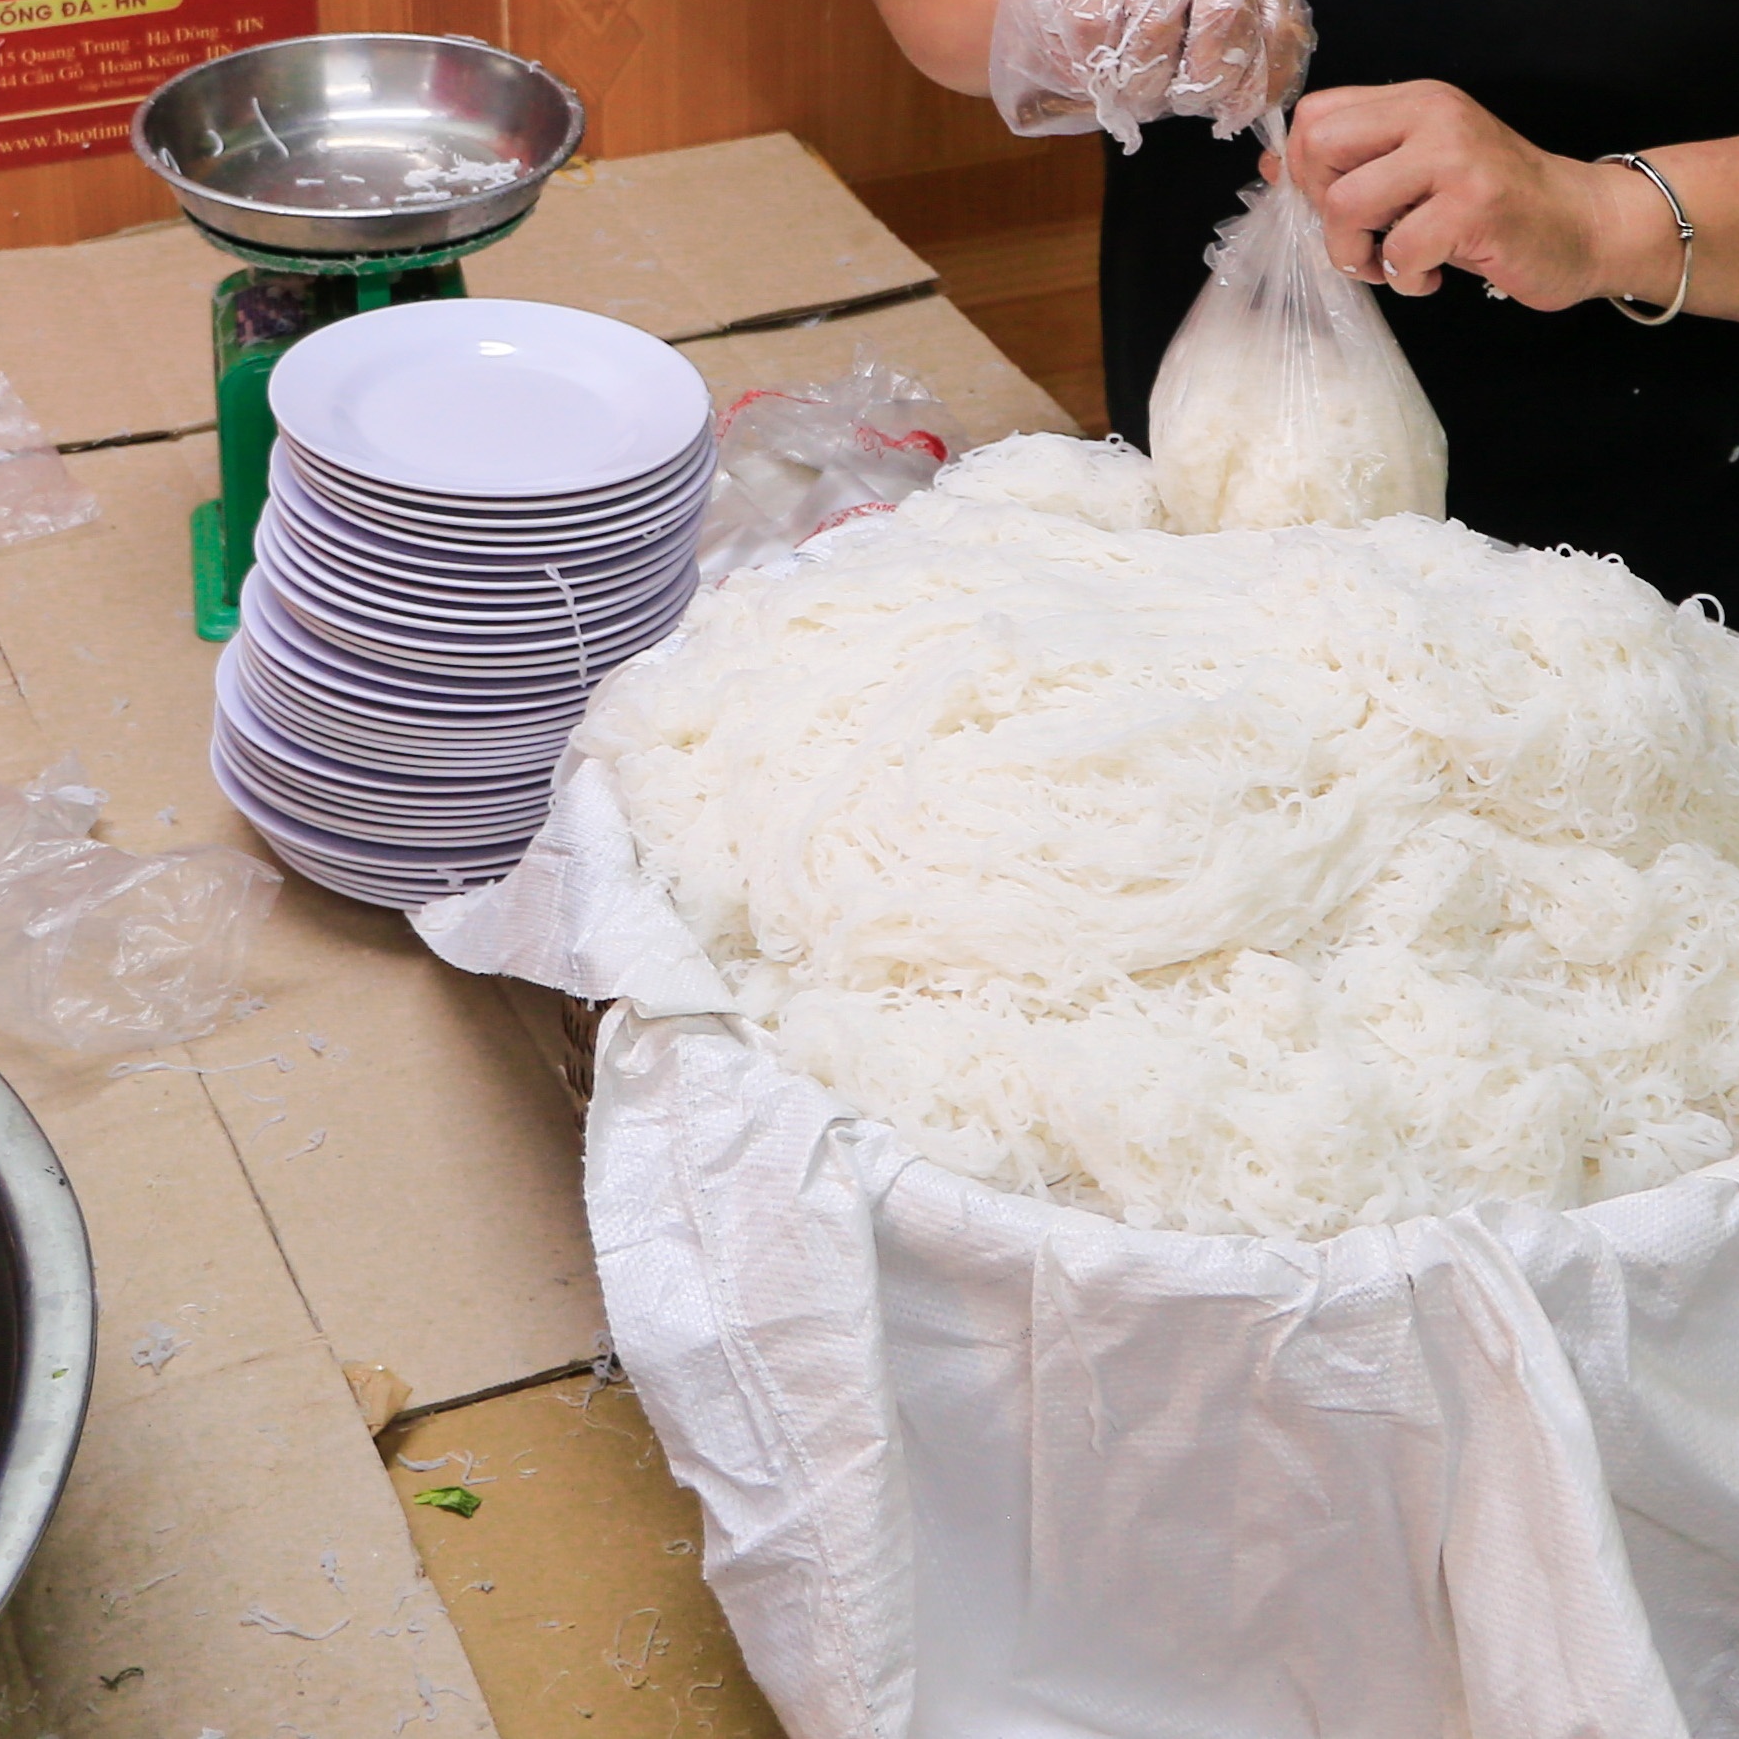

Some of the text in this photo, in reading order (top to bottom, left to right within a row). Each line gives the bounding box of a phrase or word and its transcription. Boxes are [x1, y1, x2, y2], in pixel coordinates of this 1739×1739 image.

[61, 1, 94, 18] ĐA
[21, 46, 76, 65] Quang
[80, 37, 131, 57] Trung
[147, 30, 169, 47] Hà
[235, 16, 264, 34] HN
